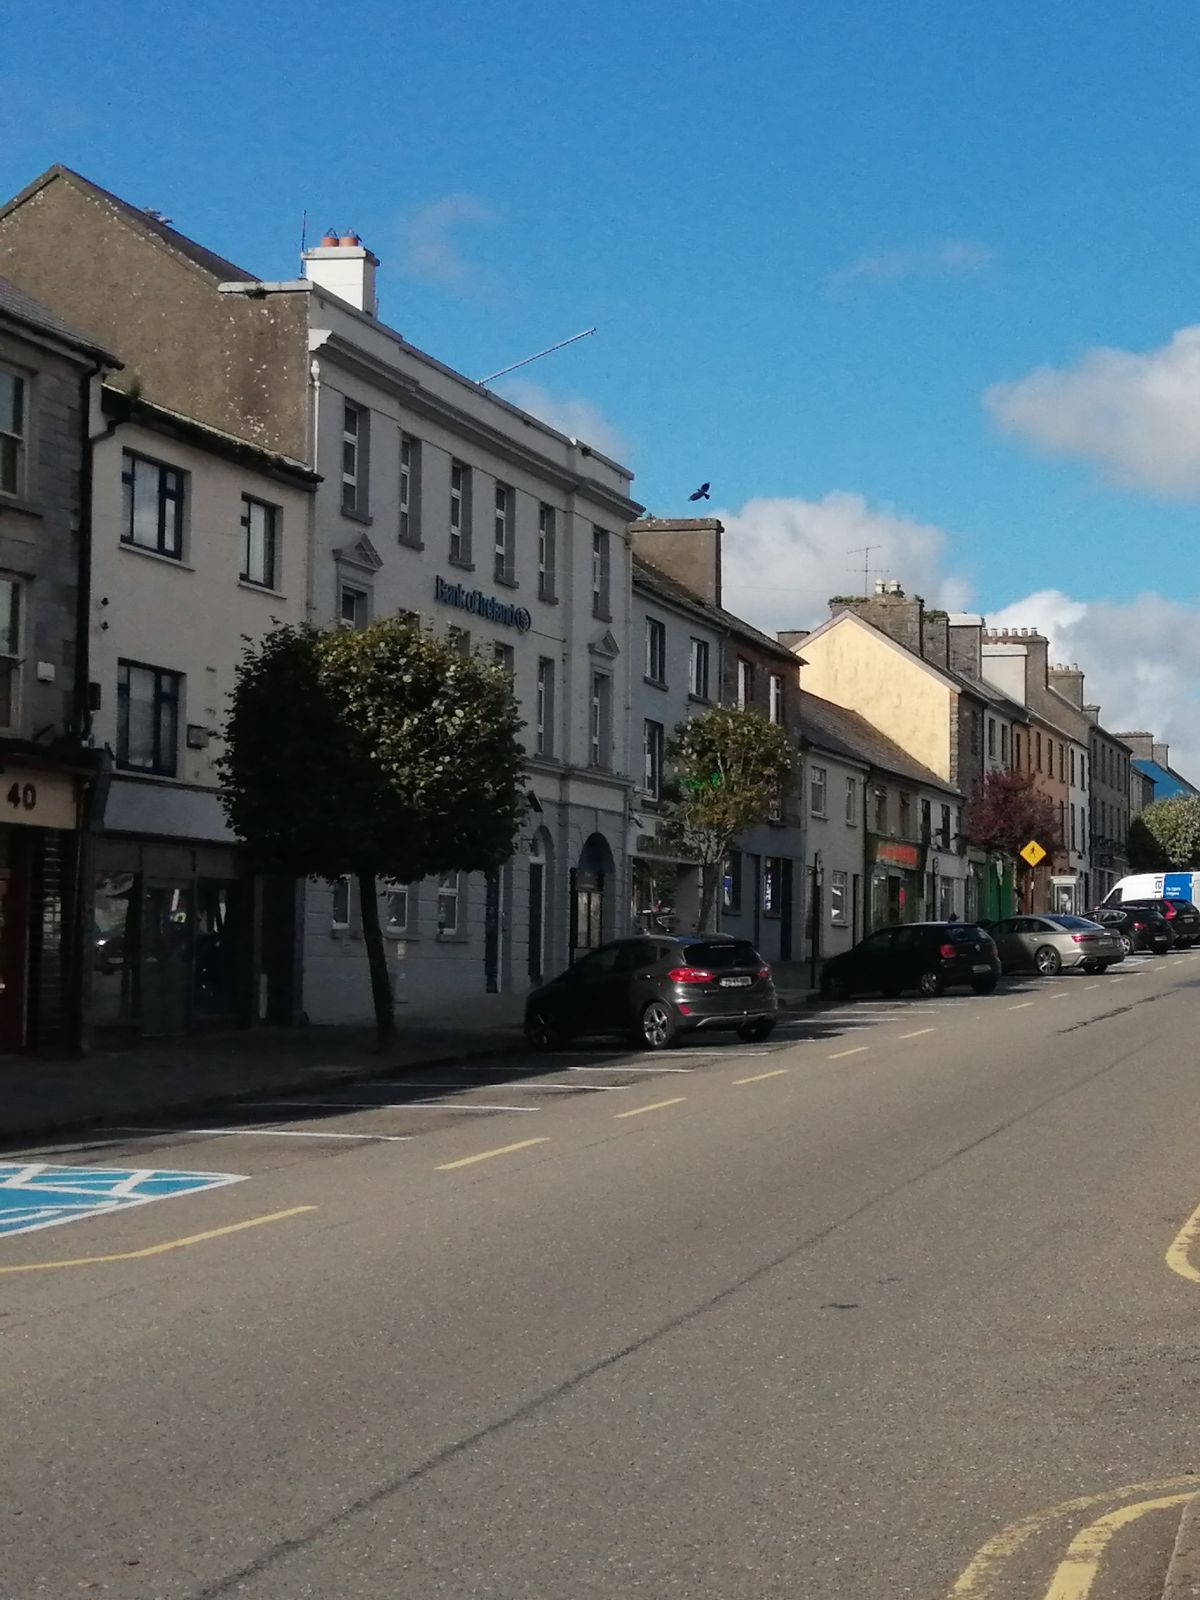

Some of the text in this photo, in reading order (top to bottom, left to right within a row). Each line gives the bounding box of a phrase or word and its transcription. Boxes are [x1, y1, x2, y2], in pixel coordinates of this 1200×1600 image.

[435, 575, 515, 627] Bank of Ireland
[7, 783, 36, 811] 40
